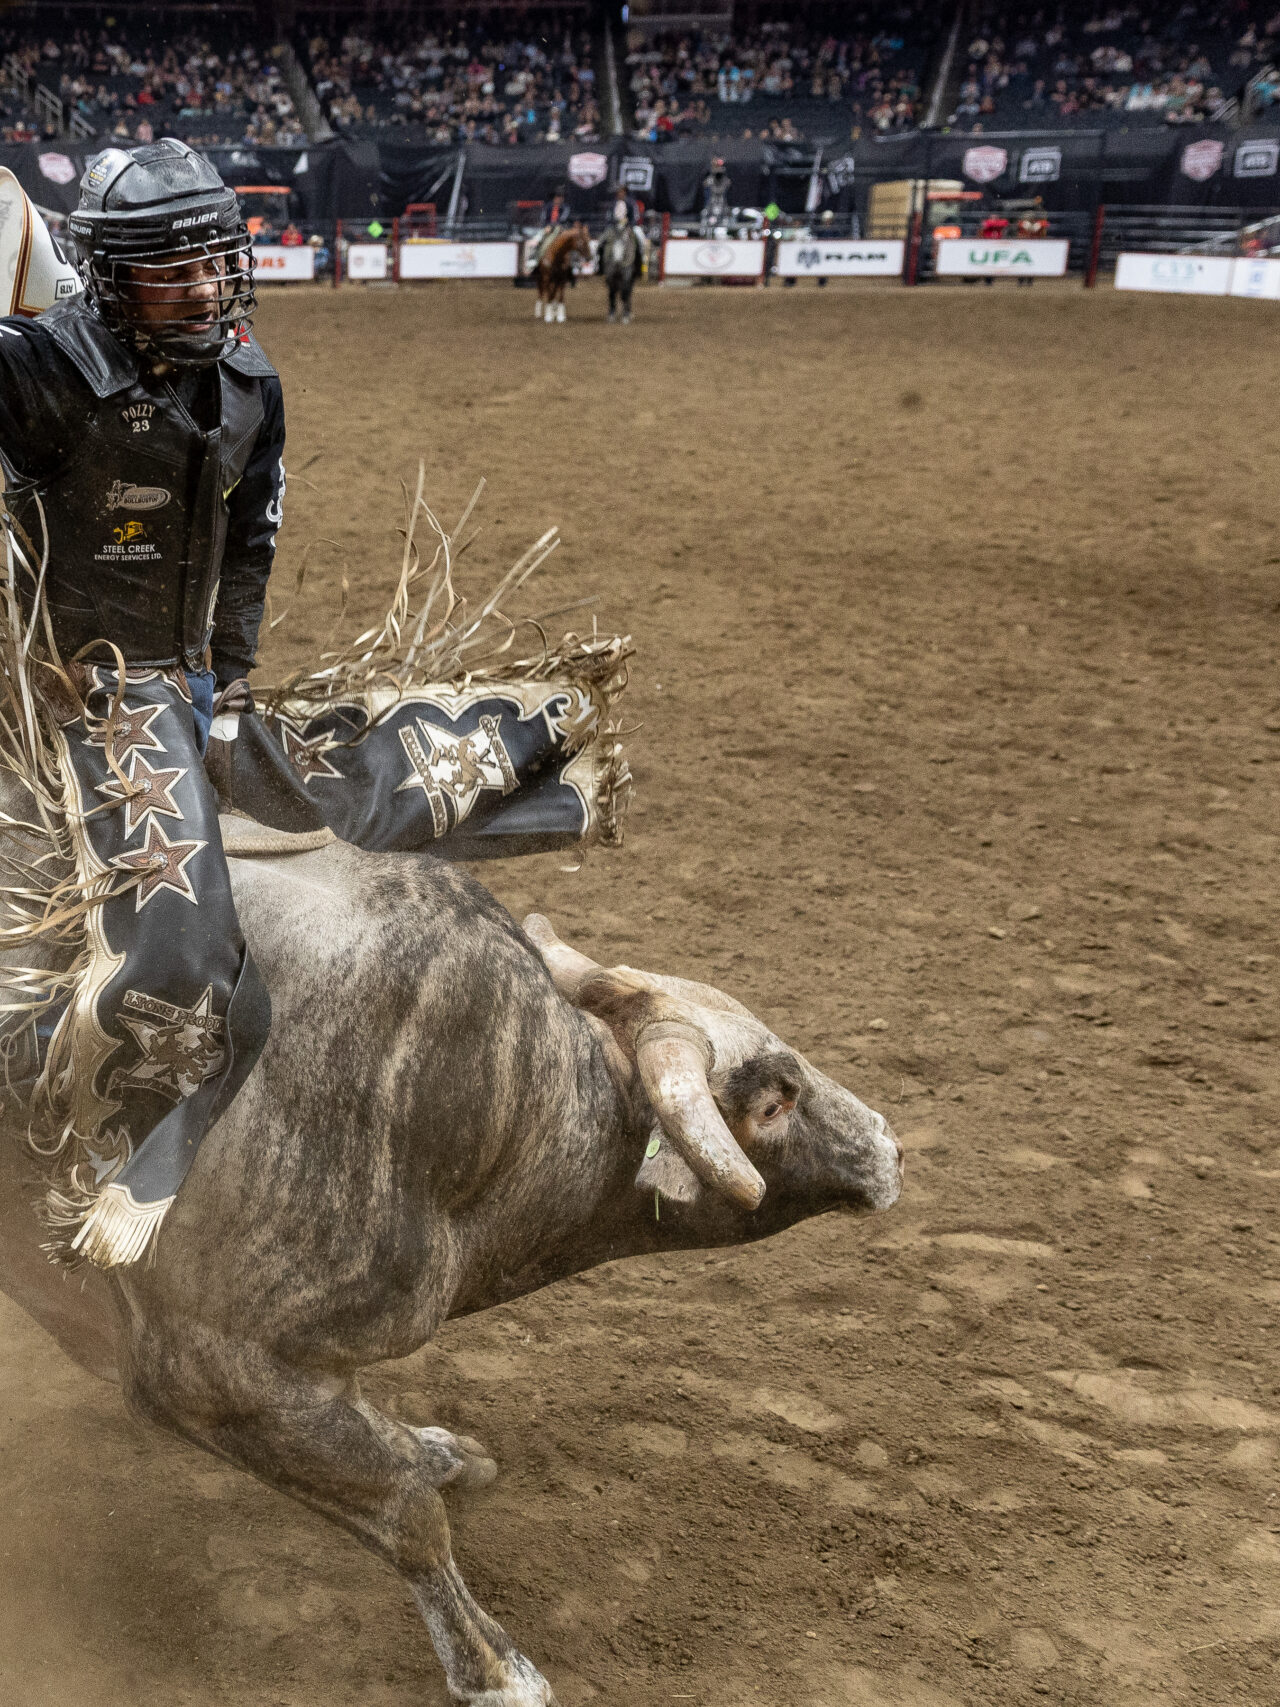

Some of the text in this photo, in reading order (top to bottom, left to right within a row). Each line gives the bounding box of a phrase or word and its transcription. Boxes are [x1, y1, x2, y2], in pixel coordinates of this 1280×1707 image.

[172, 211, 218, 229] BAUER
[969, 250, 1033, 264] UFA
[60, 284, 73, 294] ATB
[121, 403, 156, 423] POZZY
[132, 419, 150, 433] 23
[102, 543, 156, 554] STEEL CREEK
[126, 991, 176, 1020] LYONS
